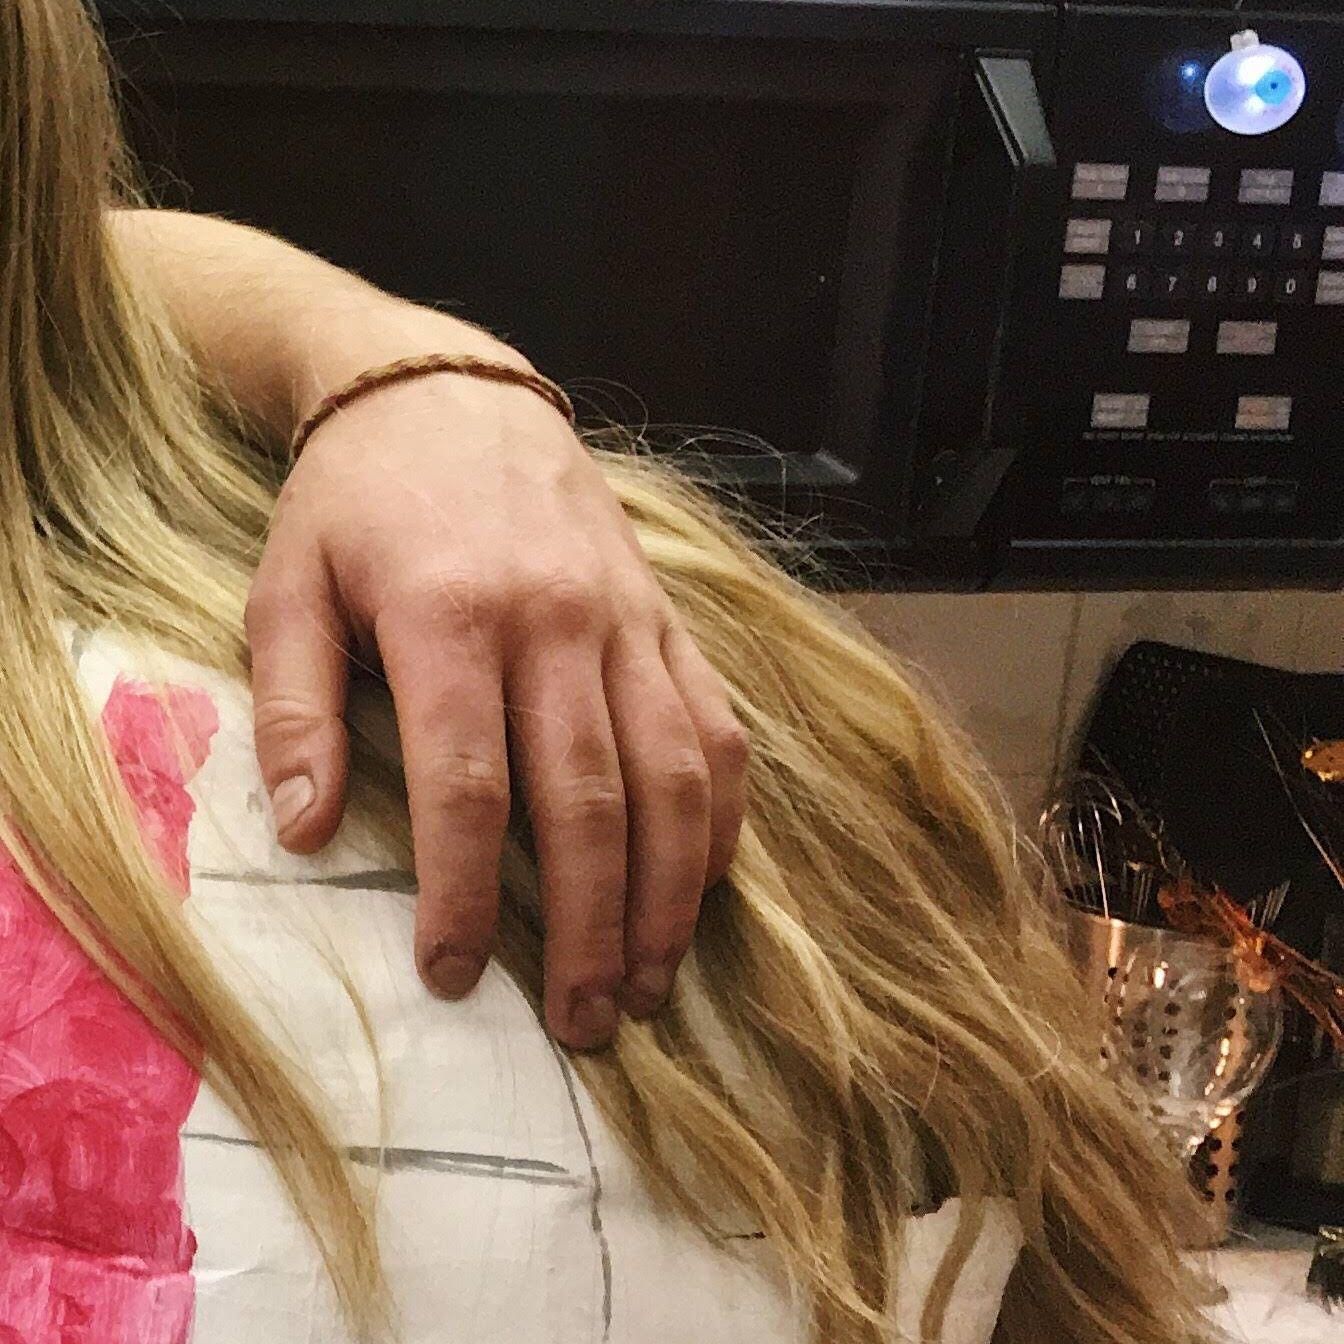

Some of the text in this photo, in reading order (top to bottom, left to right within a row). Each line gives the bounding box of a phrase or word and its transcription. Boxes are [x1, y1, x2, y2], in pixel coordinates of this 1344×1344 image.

[1252, 233, 1262, 249] 4
[1168, 276, 1178, 292] 7
[1285, 278, 1296, 295] 0
